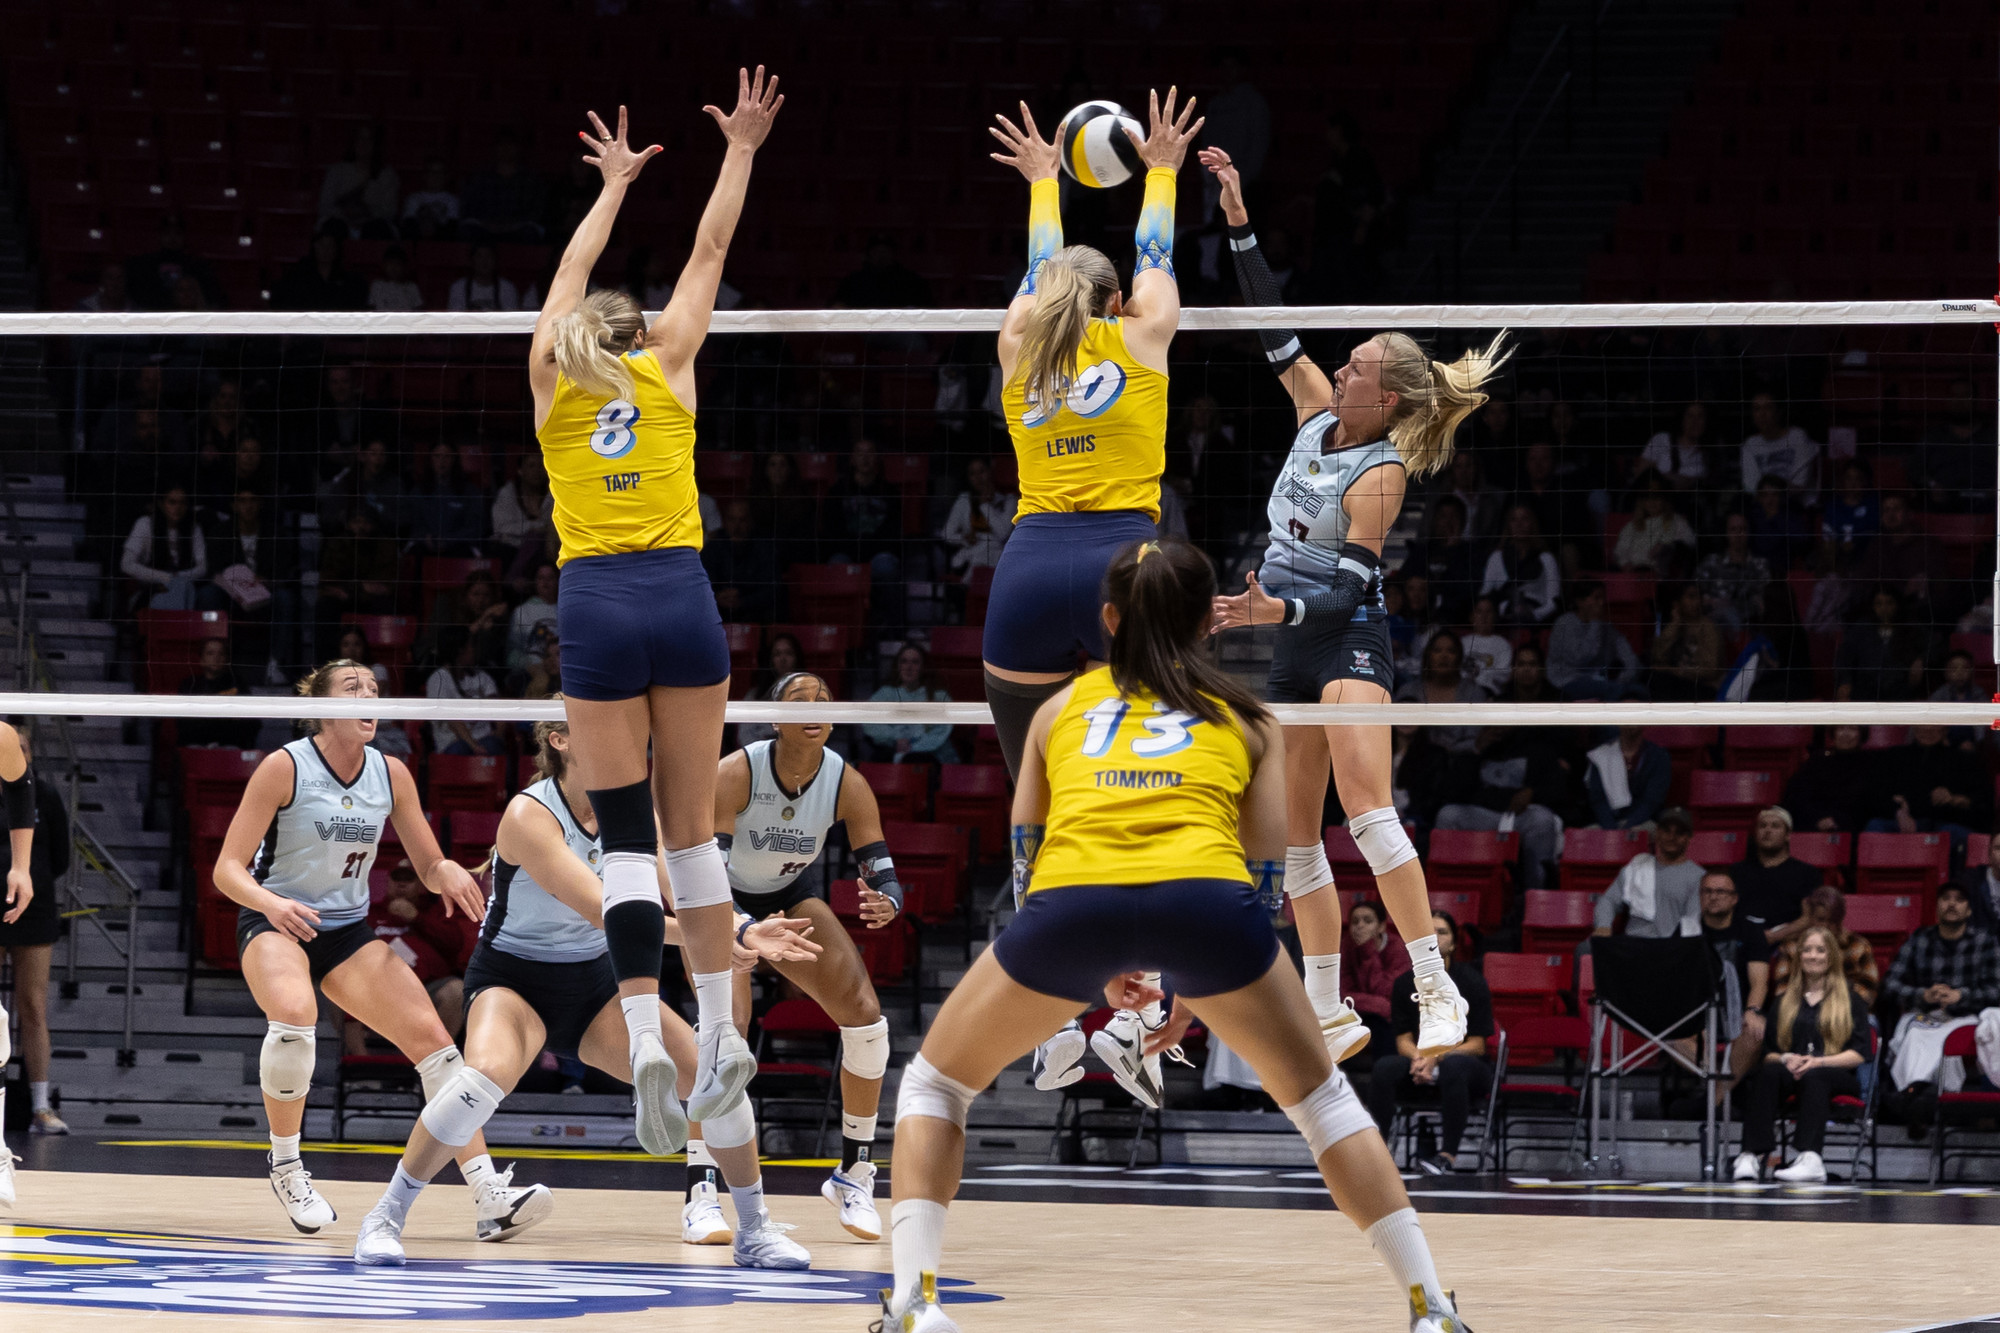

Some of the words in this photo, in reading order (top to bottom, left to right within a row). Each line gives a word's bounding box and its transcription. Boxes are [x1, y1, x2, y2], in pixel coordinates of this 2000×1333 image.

[1942, 303, 1977, 312] SPALDING
[589, 398, 641, 459] 8
[1046, 434, 1097, 458] LEWIS
[602, 472, 641, 492] TAPP
[1291, 471, 1315, 492] ATLANTA
[1278, 470, 1326, 519] VIBE
[1287, 518, 1310, 543] 17
[1081, 697, 1205, 758] 13
[1093, 769, 1184, 789] TOMKOM
[330, 815, 366, 824] ATLANTA
[765, 826, 804, 836] ATLANTA
[314, 821, 378, 844] VIBE
[749, 830, 817, 855] VIBE
[341, 851, 369, 879] 21
